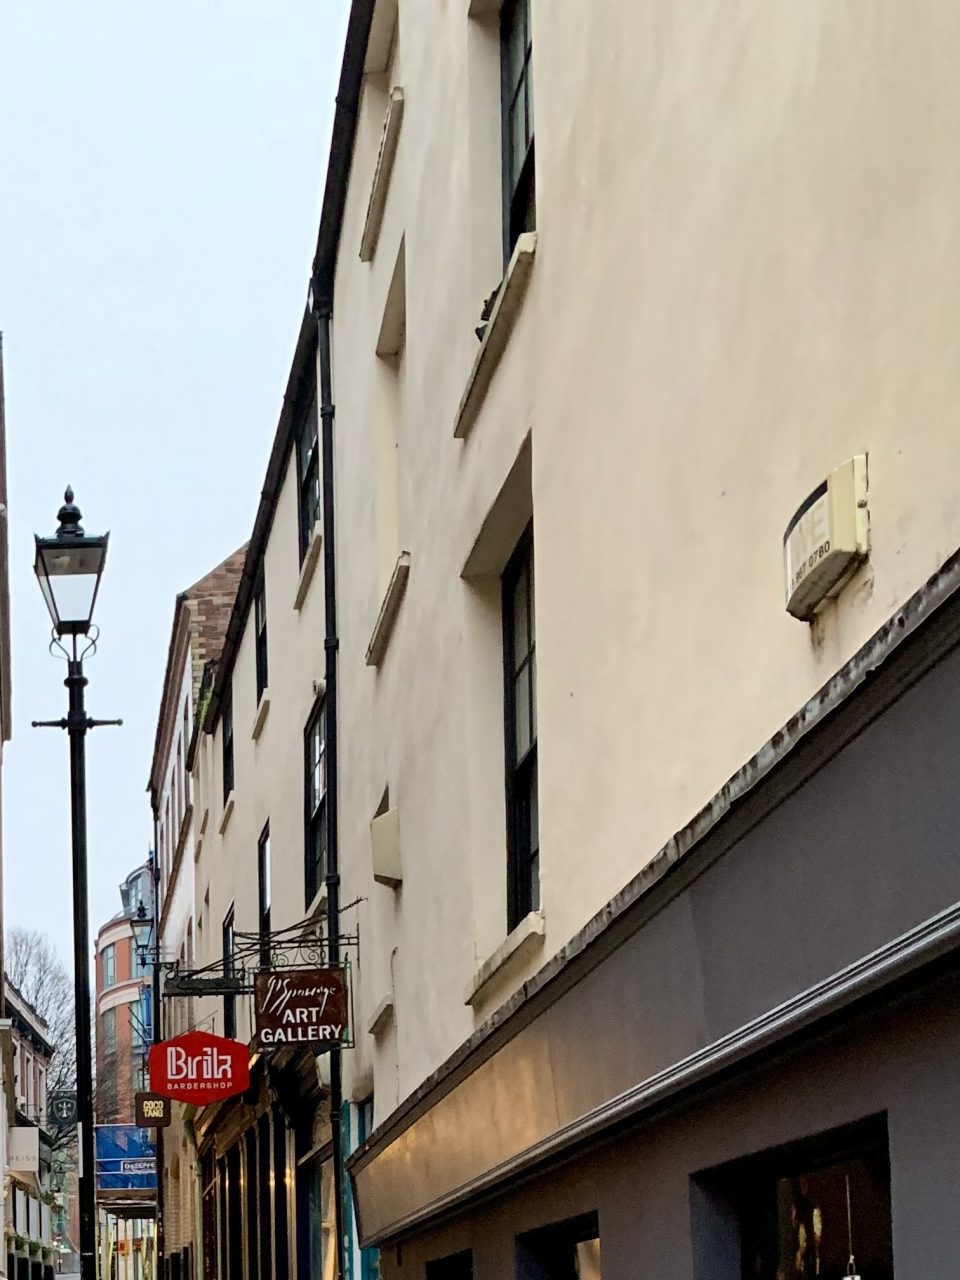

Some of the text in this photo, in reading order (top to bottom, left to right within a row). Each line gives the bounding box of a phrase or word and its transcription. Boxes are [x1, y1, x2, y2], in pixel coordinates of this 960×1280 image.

[282, 1007, 320, 1024] ART
[260, 1024, 342, 1043] GALLERY
[167, 1046, 233, 1080] Brik
[167, 1082, 233, 1091] BARBERSHOP
[143, 1100, 164, 1109] COCO
[143, 1109, 164, 1118] TANG
